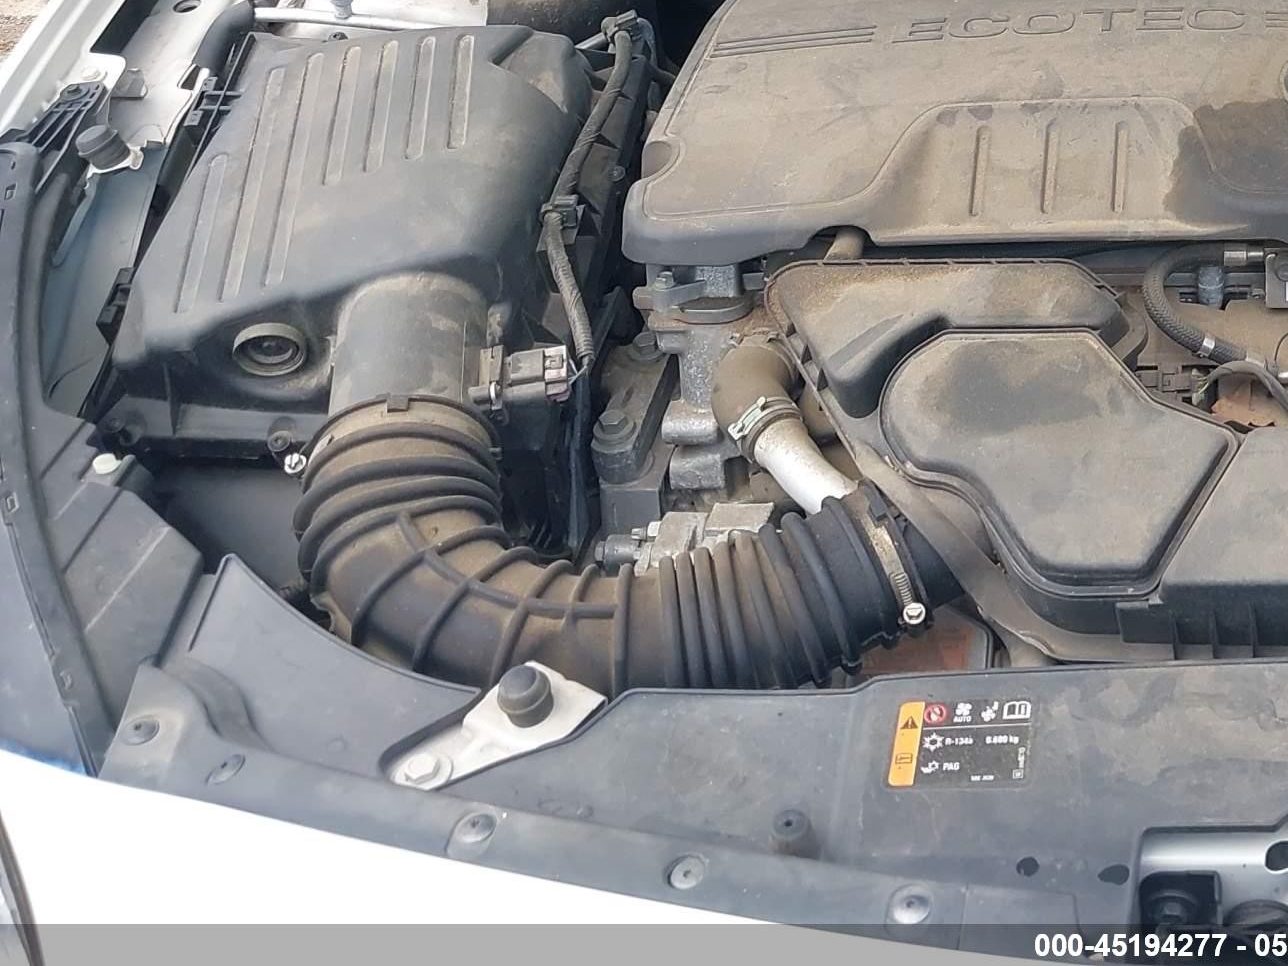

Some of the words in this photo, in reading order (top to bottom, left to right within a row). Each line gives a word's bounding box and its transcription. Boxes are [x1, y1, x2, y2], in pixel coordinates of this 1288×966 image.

[891, 8, 1245, 44] ECOTEC
[953, 715, 972, 723] AUTO
[942, 762, 960, 771] PAG
